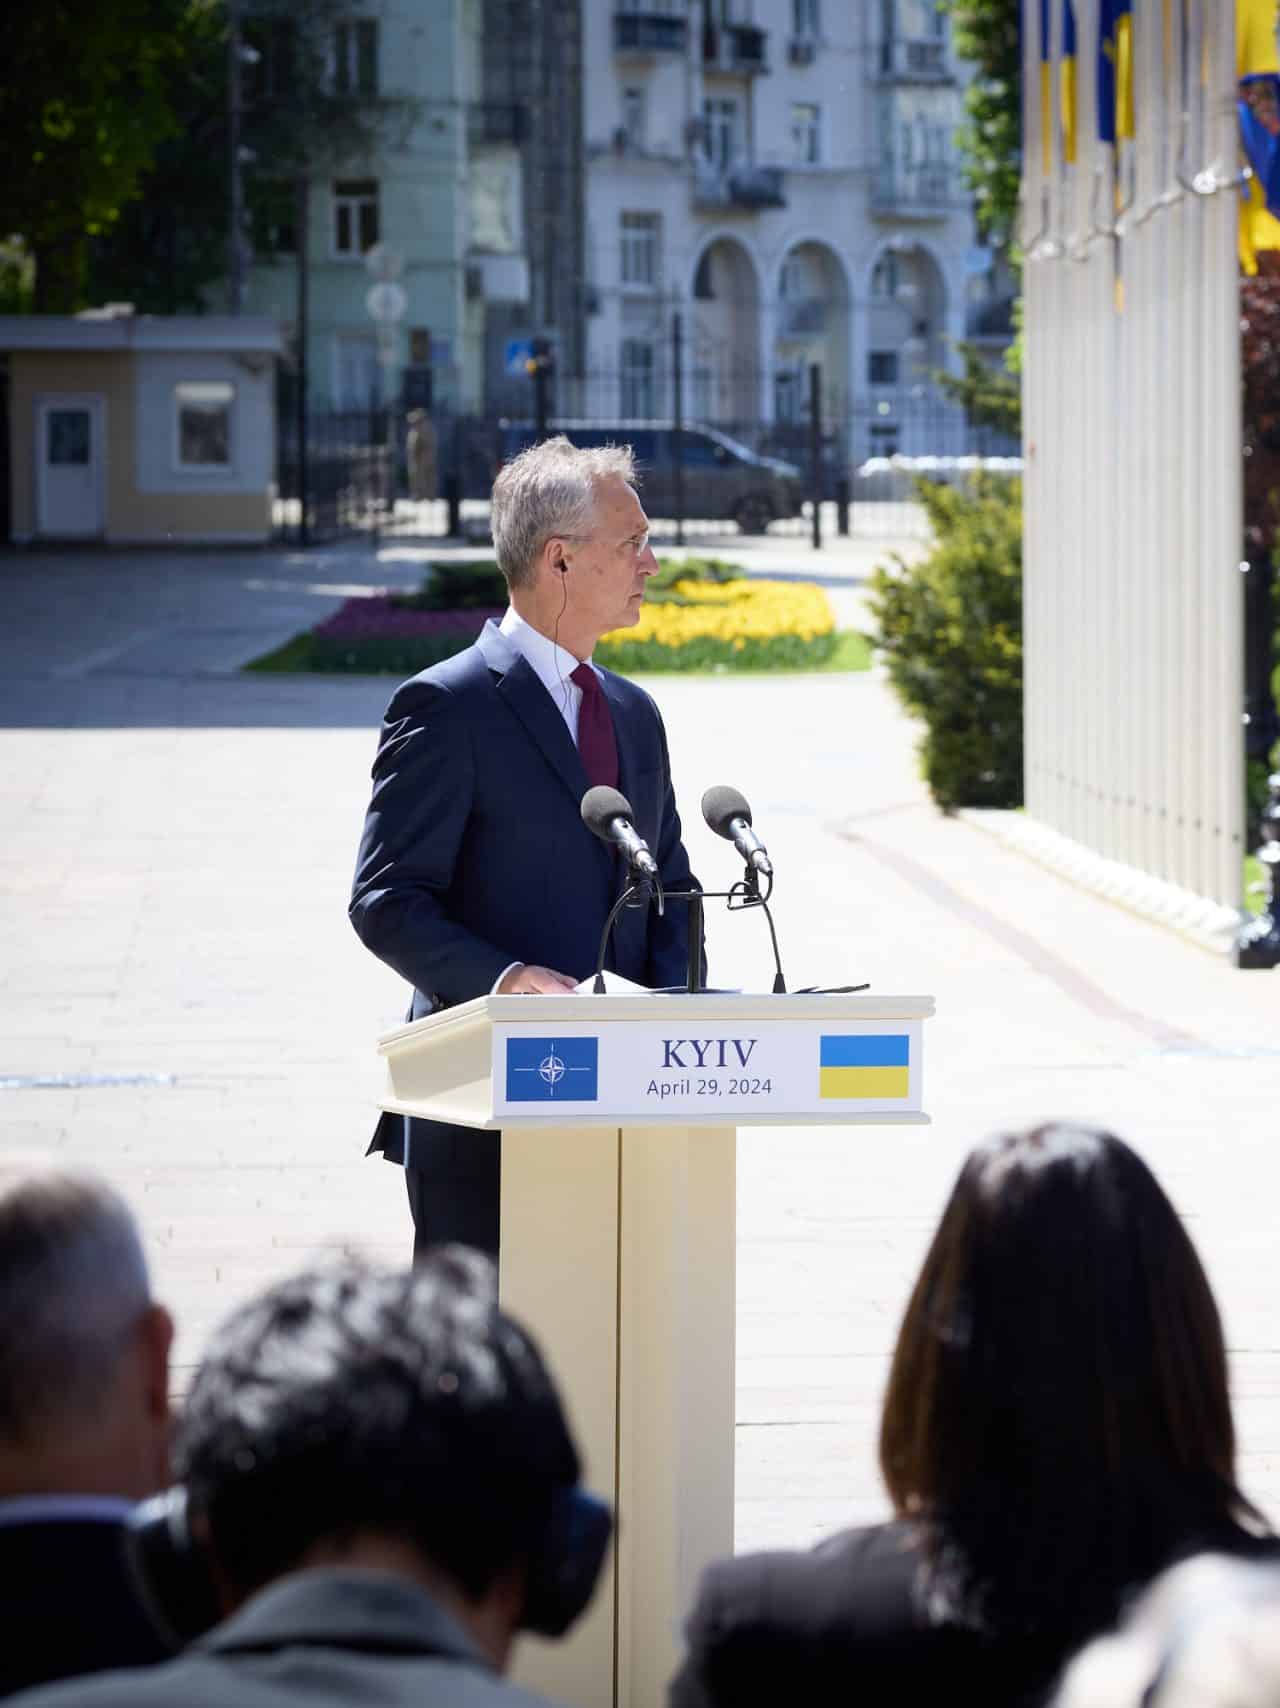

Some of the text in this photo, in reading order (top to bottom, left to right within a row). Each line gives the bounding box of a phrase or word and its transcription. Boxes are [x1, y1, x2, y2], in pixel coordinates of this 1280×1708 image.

[660, 1039, 759, 1068] KYIV
[646, 1078, 773, 1099] April 29, 2024
